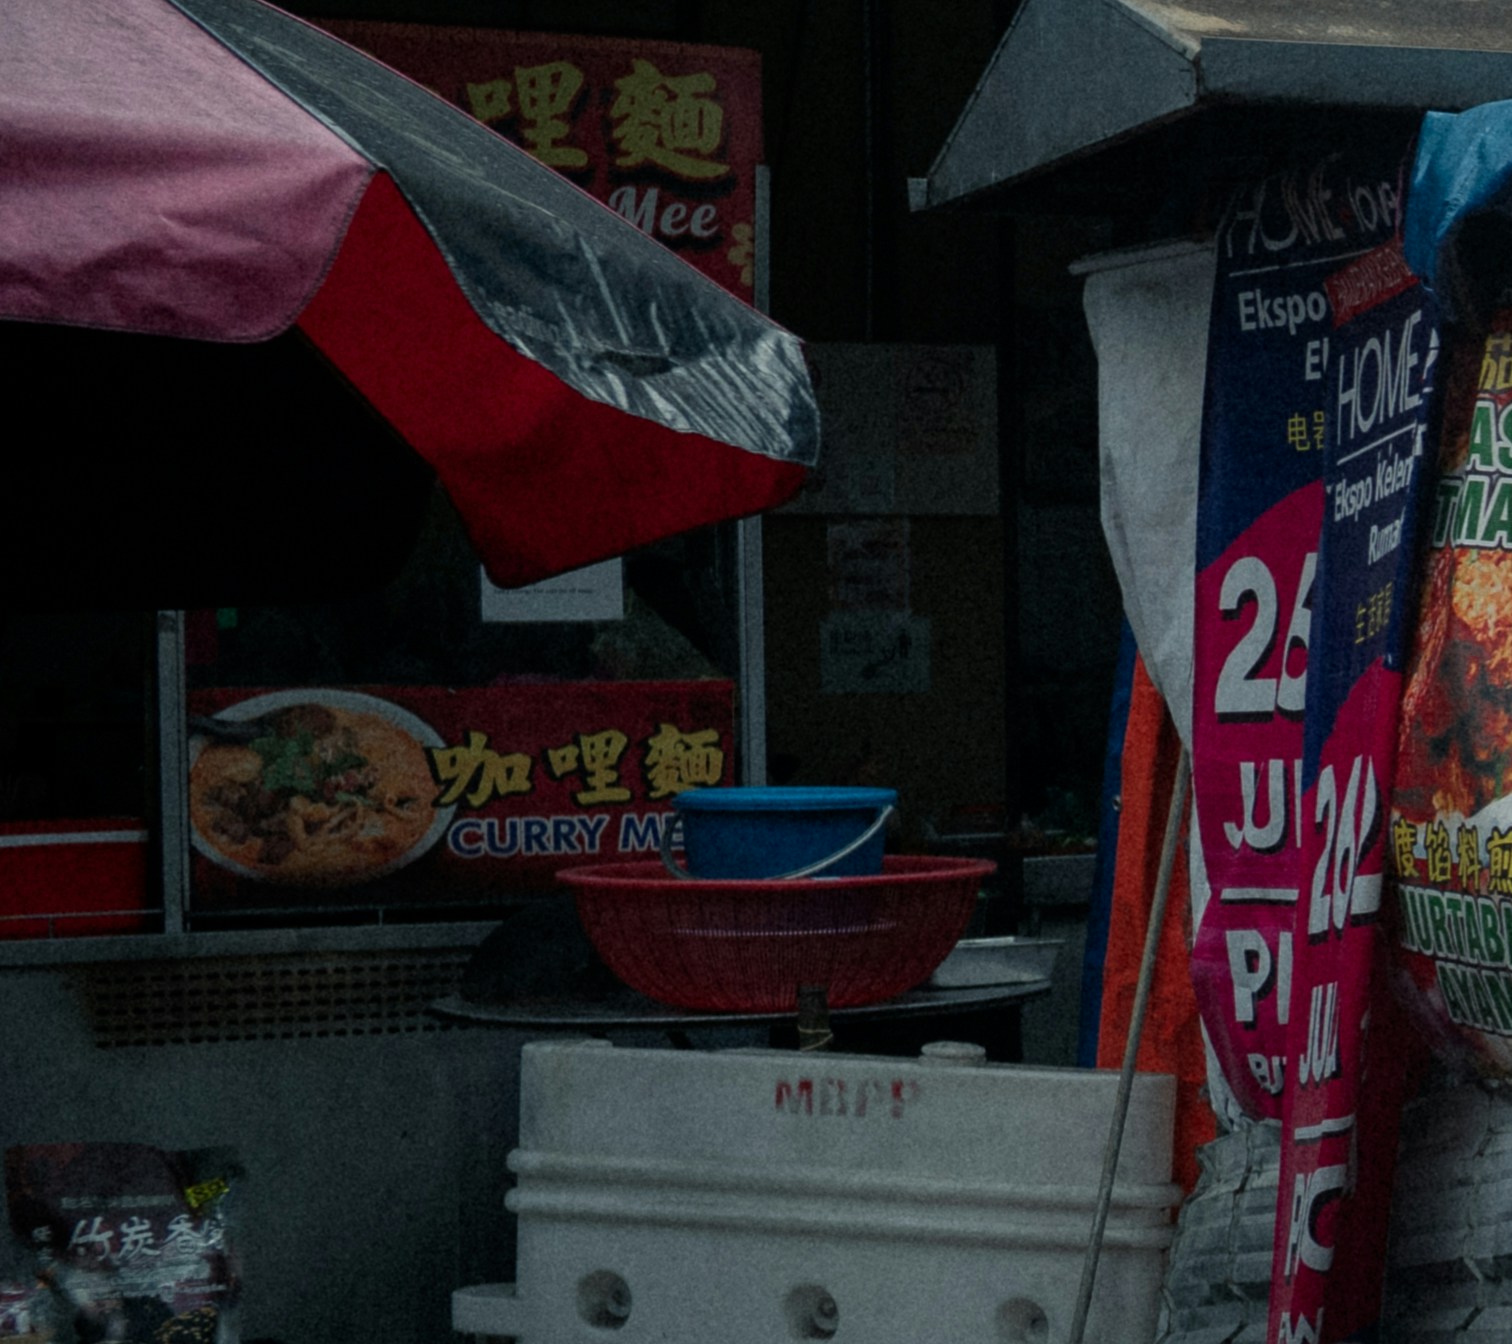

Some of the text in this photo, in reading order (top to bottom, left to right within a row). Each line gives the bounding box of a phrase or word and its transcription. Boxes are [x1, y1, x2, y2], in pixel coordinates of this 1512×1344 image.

[467, 58, 731, 182] 哩麵
[608, 184, 720, 242] Mee
[1237, 288, 1327, 336] Ekspo
[430, 722, 728, 809] 咖哩麵
[449, 814, 688, 858] CURRY ME
